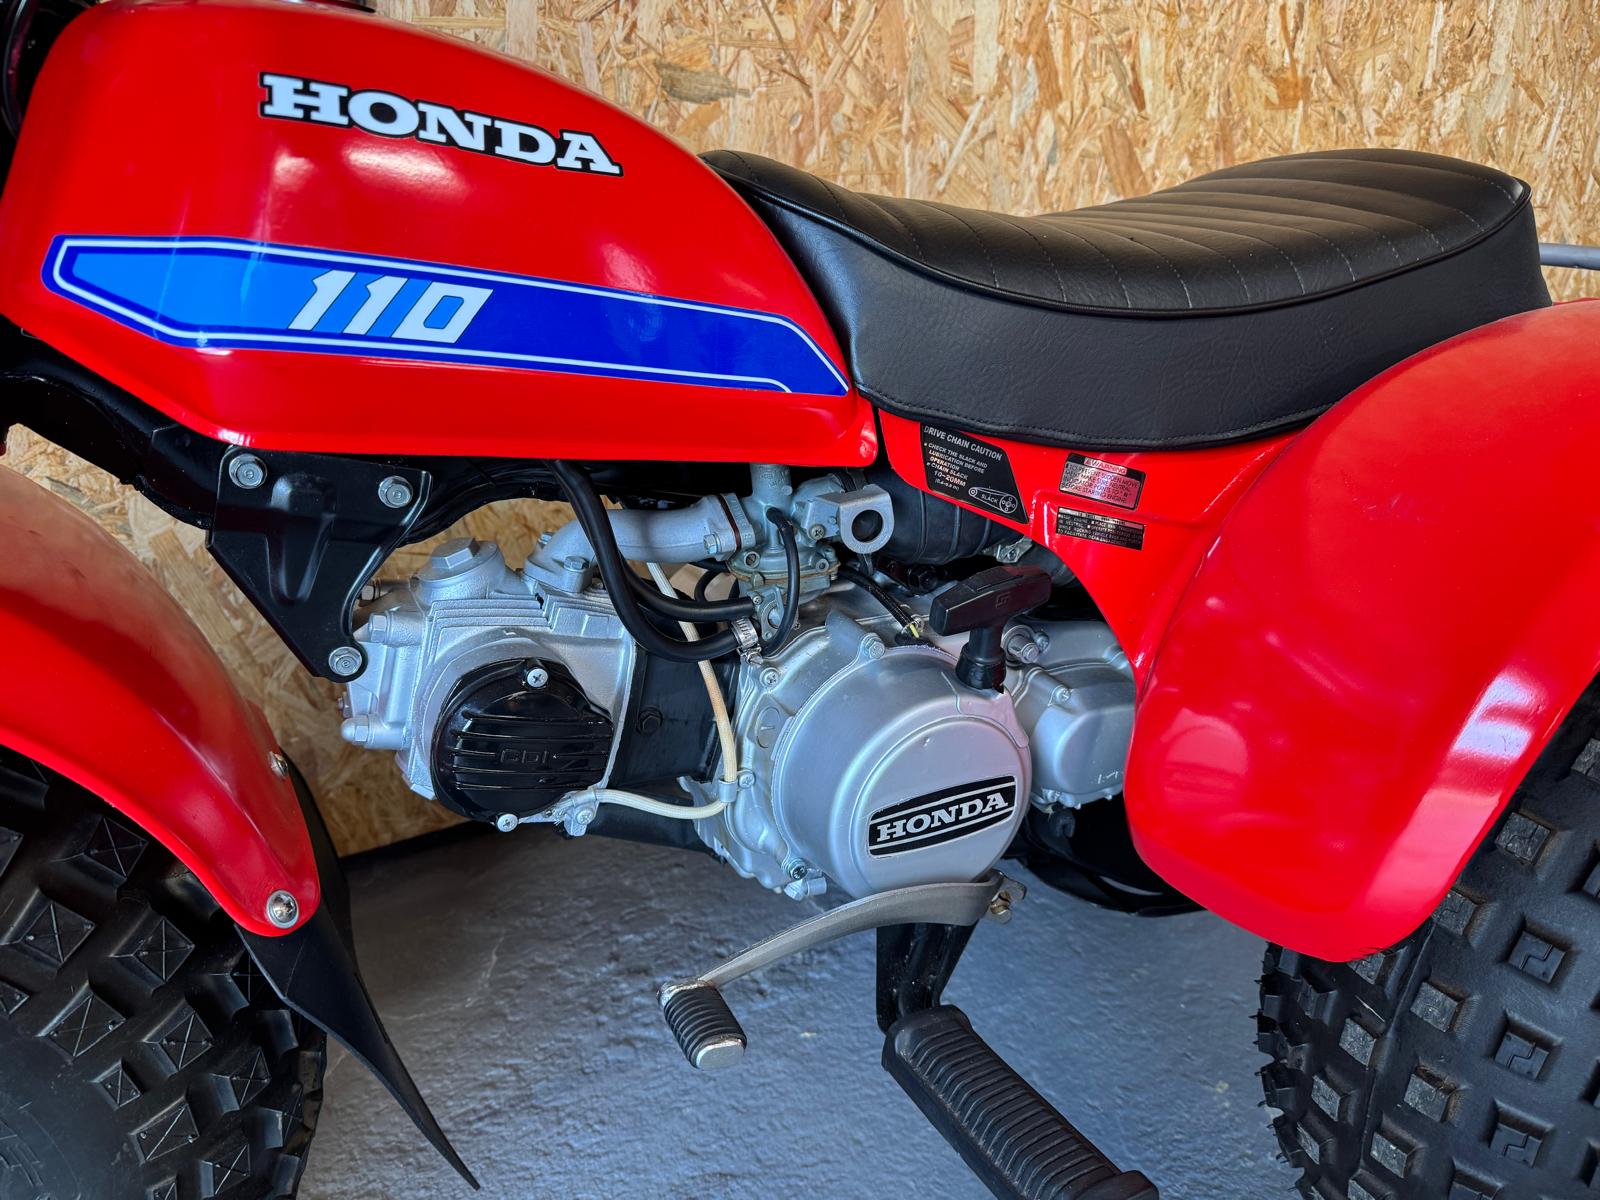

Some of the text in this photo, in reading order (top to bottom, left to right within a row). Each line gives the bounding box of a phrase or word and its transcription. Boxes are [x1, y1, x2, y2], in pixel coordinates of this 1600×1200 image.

[260, 73, 622, 175] HONDA
[288, 269, 493, 343] 110
[924, 426, 1002, 460] DRIVE CHAIN CAUTION
[928, 442, 946, 453] CHECK
[959, 454, 976, 464] SLACK
[929, 450, 985, 473] LUBRICATION BEFORE
[930, 456, 960, 471] OPERATION
[931, 462, 968, 480] CHAIN SLACK
[1091, 459, 1126, 474] WARNING
[980, 494, 998, 504] SLACK
[876, 792, 1008, 842] HONDA
